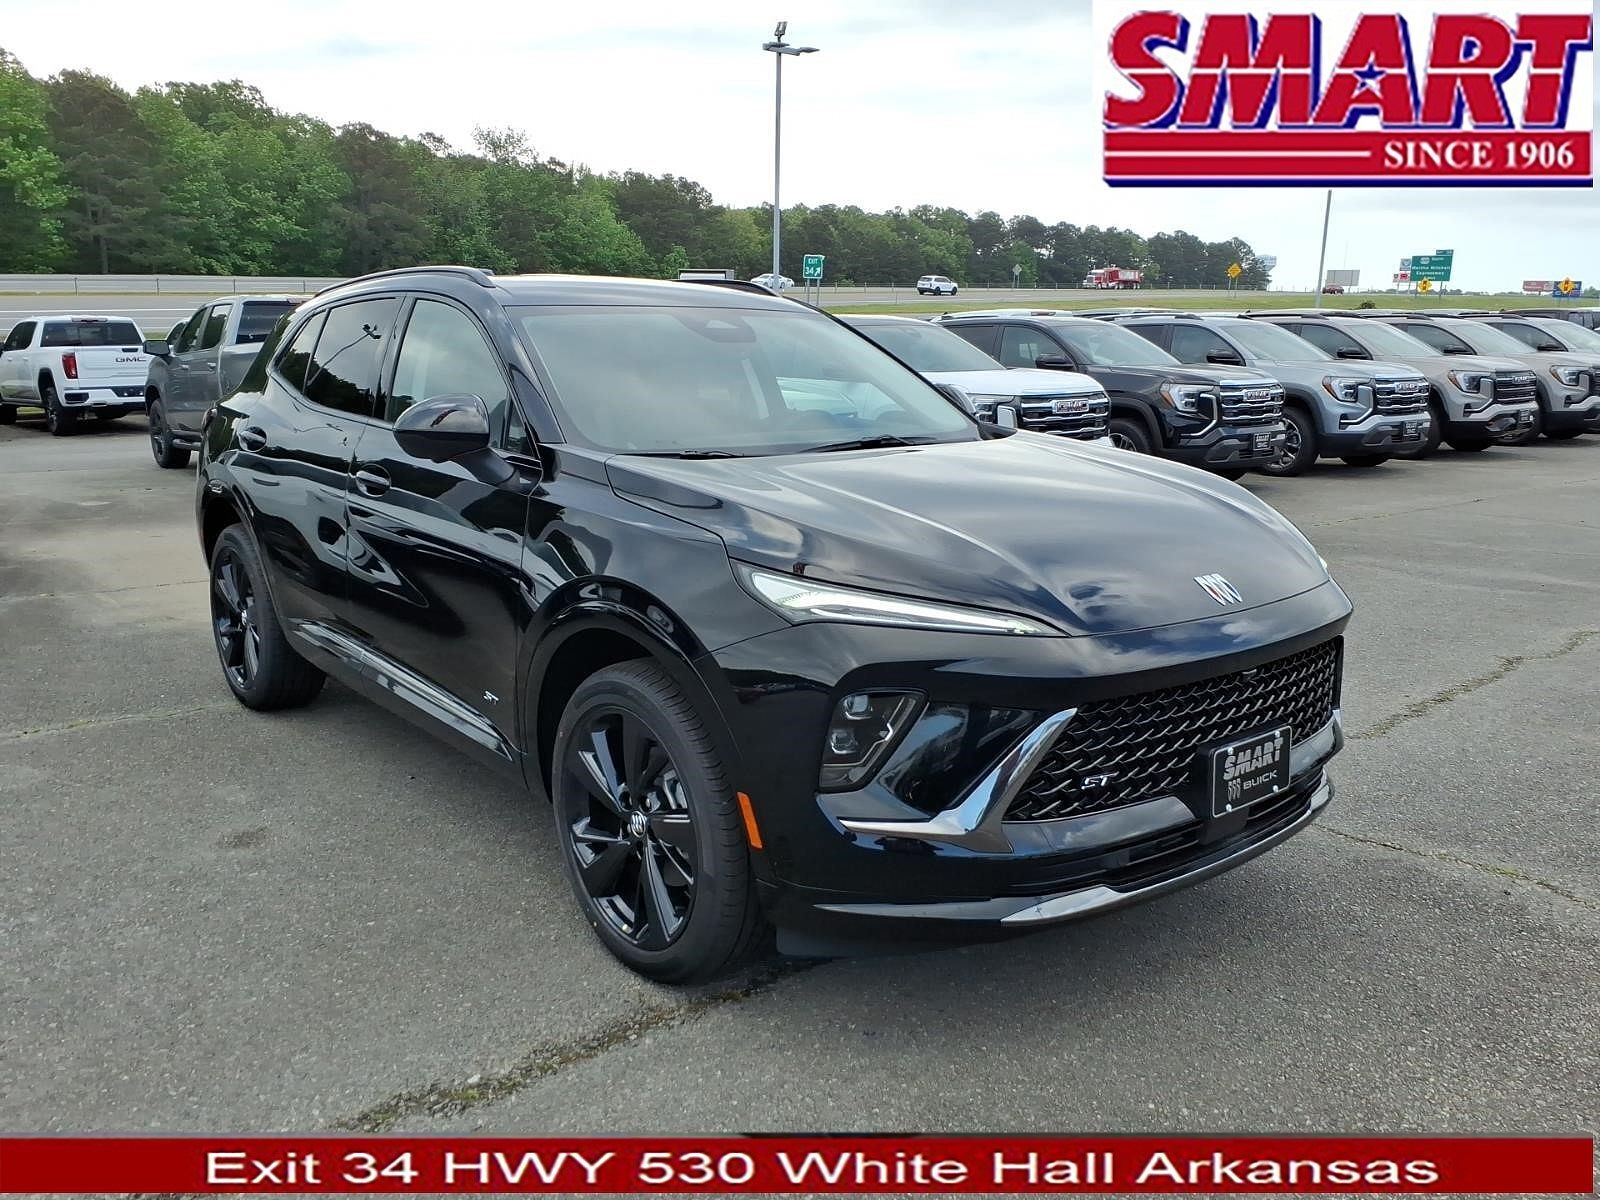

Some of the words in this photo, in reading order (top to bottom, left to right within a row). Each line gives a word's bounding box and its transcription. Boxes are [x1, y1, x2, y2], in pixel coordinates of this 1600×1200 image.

[805, 266, 814, 275] 34
[1223, 737, 1284, 780] SMART
[1081, 770, 1120, 790] ST
[1243, 769, 1278, 790] BUICK
